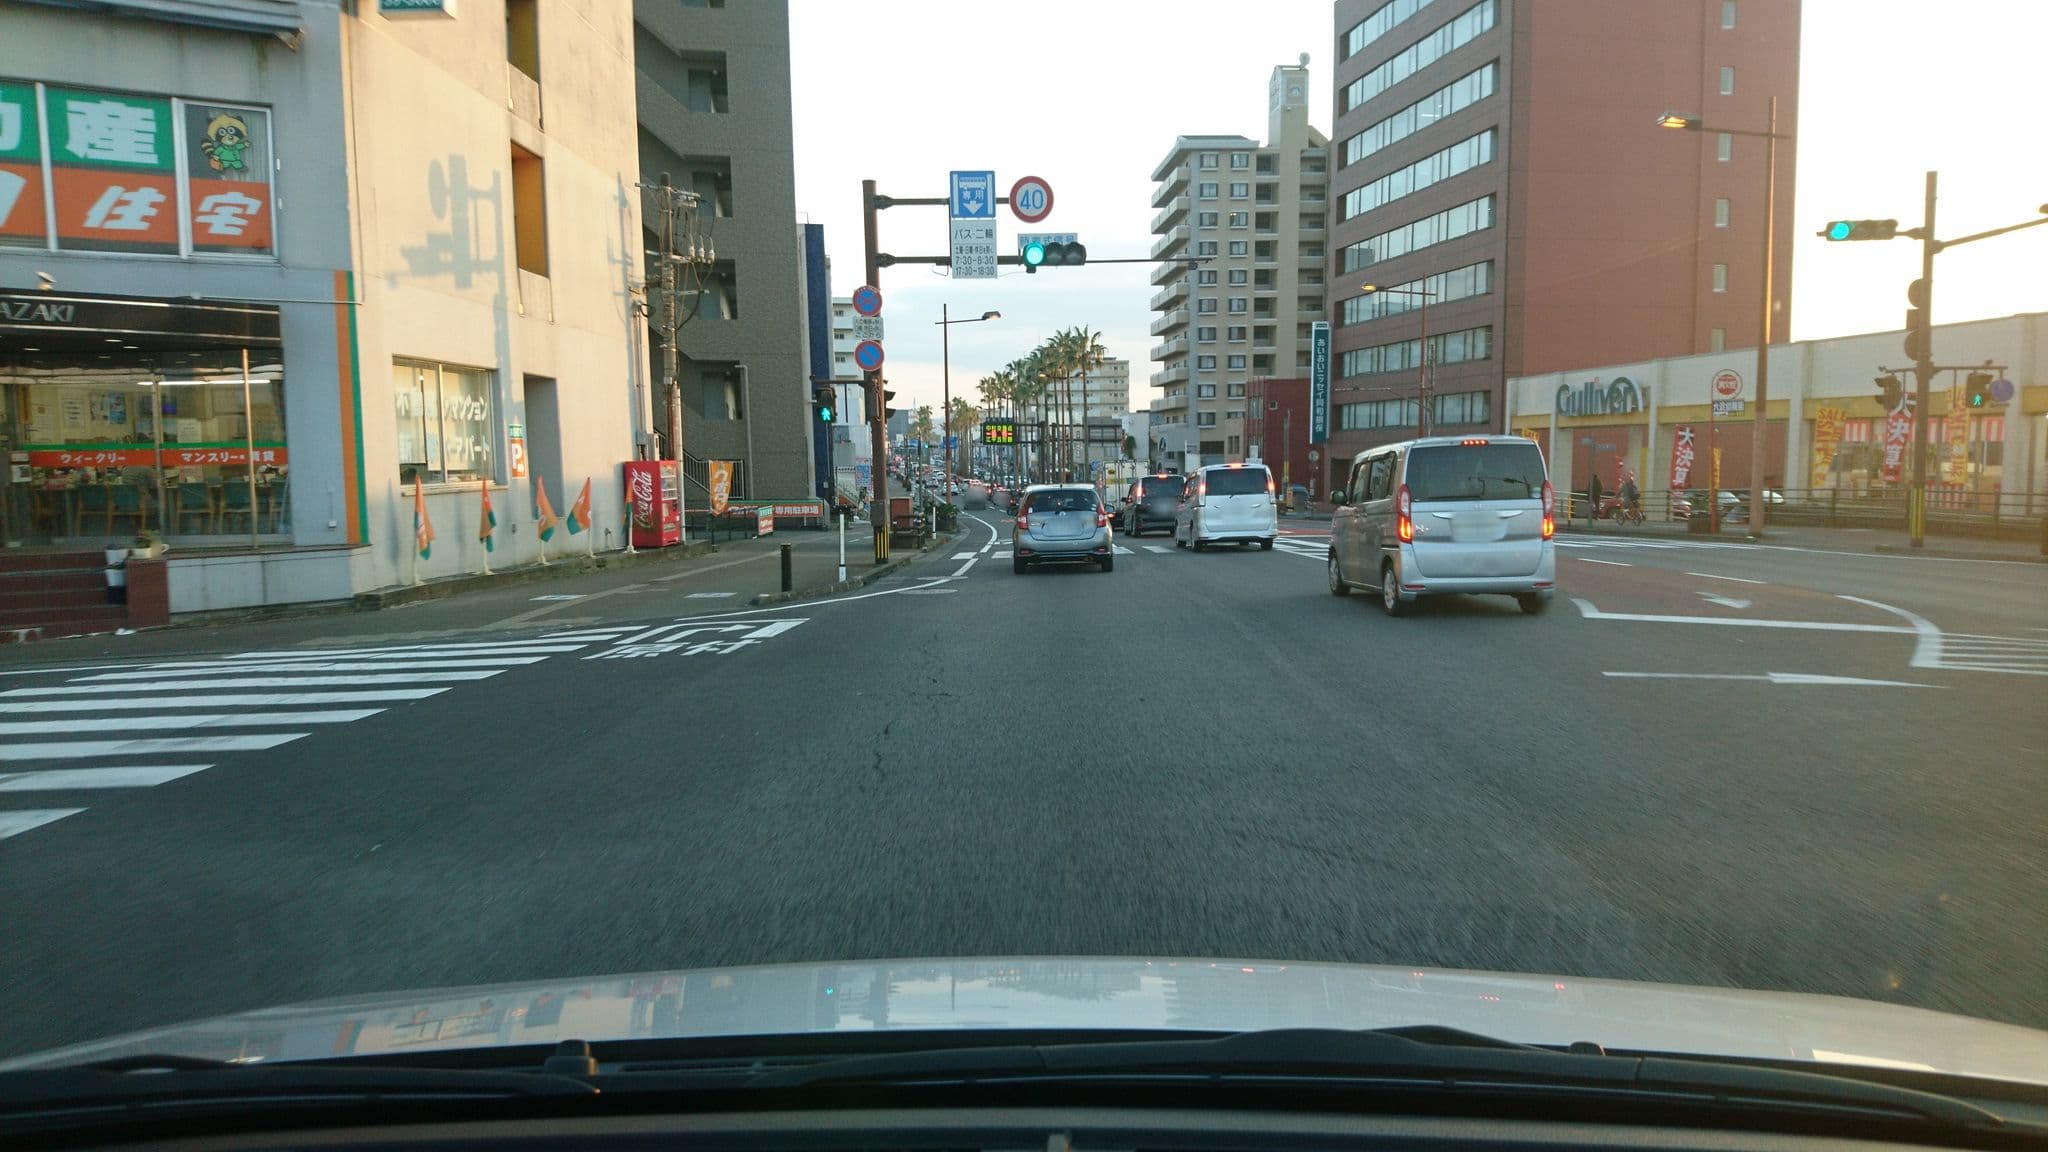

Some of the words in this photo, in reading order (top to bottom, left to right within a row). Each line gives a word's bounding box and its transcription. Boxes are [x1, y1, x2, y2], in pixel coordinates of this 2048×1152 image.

[962, 189, 984, 200] 専用
[1020, 189, 1043, 210] 40
[1556, 376, 1643, 417] Gulliver
[60, 453, 127, 464] ウィークリー
[632, 468, 653, 528] Coca-Cola
